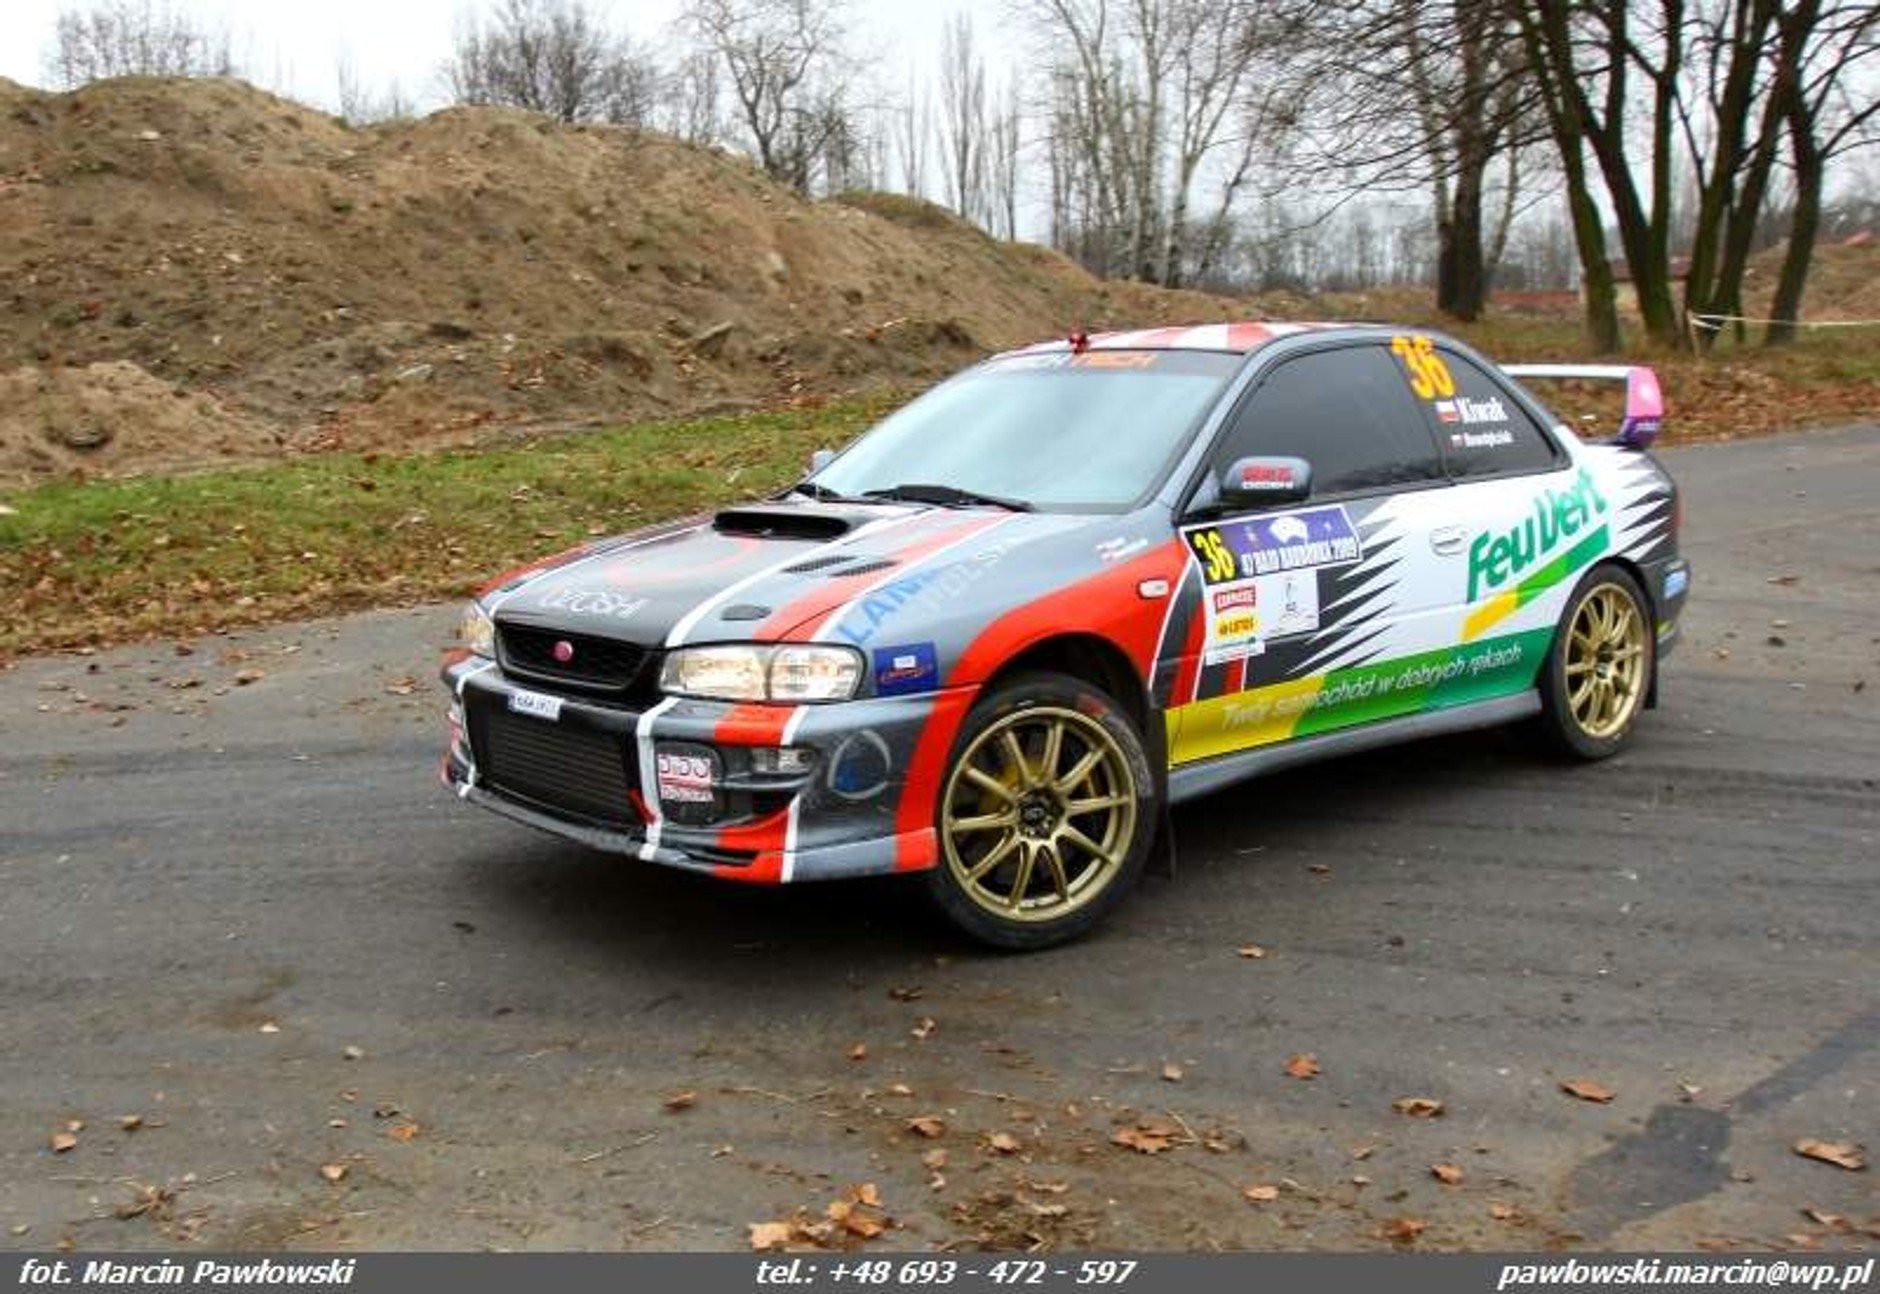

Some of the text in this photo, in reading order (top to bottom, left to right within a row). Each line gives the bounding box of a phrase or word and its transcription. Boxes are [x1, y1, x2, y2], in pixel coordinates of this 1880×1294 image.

[1391, 336, 1457, 399] 36
[1193, 530, 1237, 582] 36
[1467, 466, 1607, 604] Feu Vert
[1377, 676, 1396, 694] w
[1395, 659, 1468, 691] dobrych
